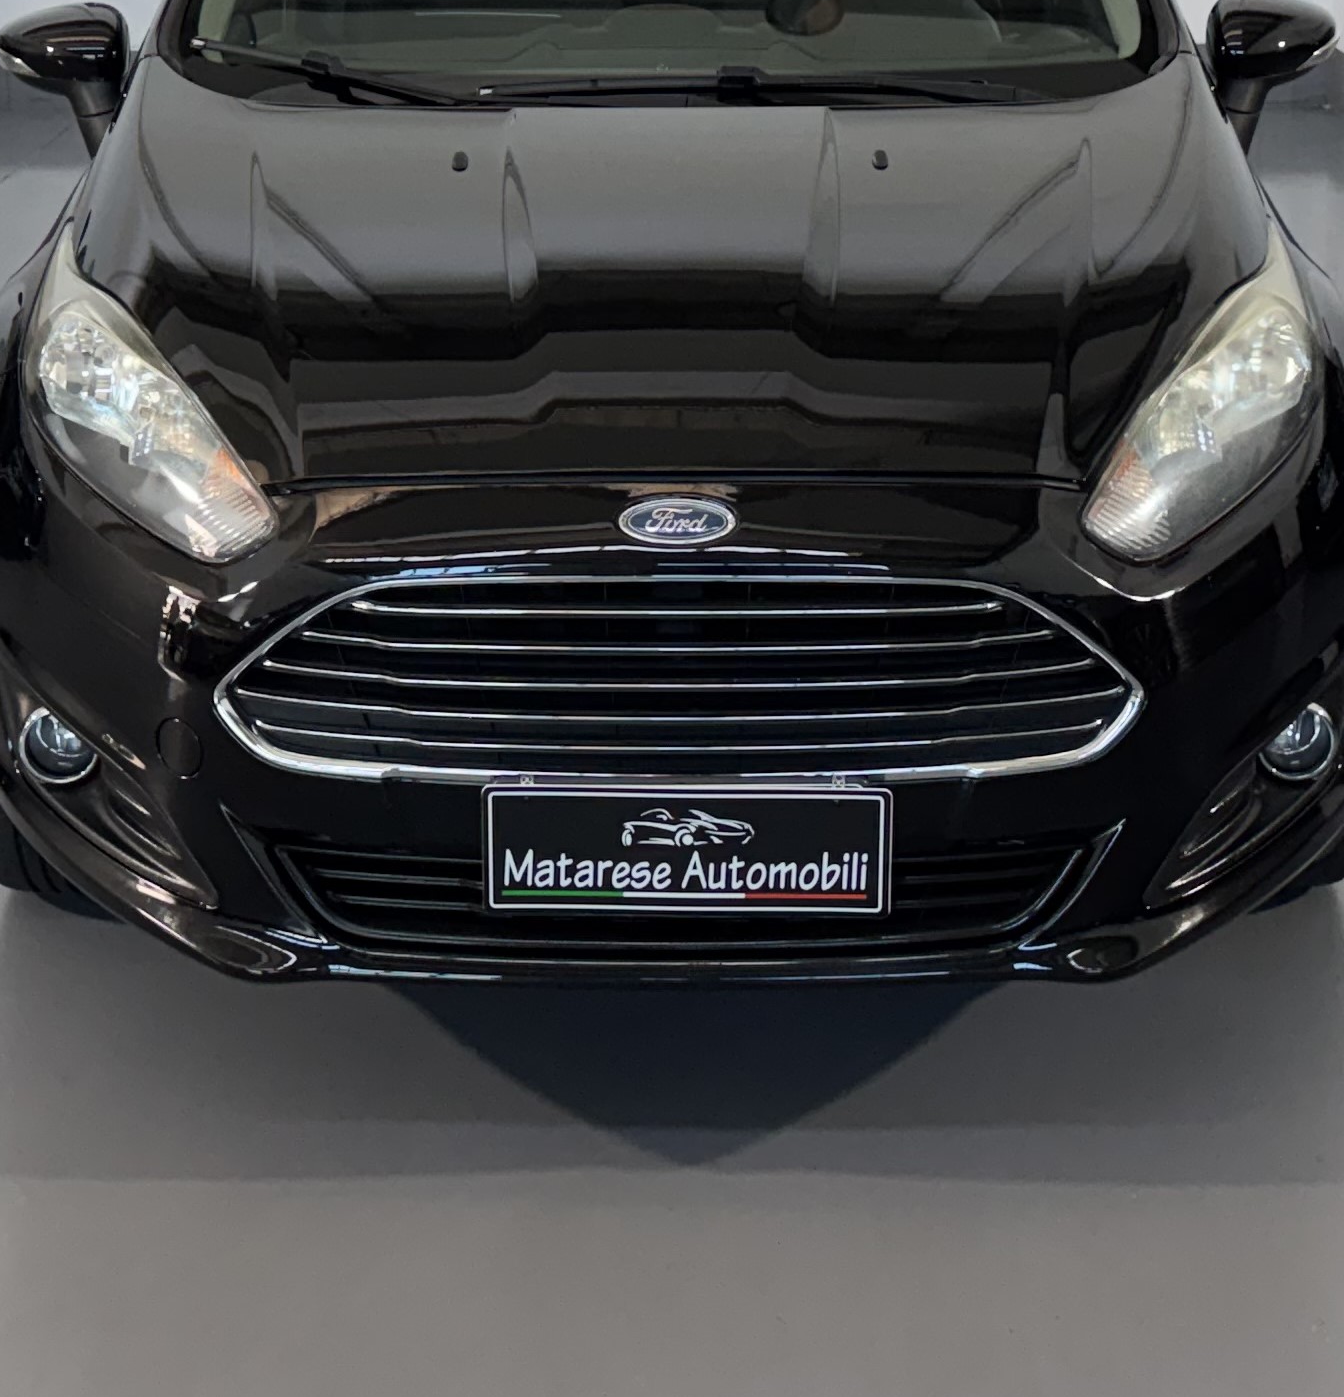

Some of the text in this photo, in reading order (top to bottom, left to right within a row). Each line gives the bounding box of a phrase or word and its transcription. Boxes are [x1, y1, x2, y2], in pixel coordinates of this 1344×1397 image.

[644, 507, 709, 534] Ford
[503, 847, 870, 891] Matarese Automobili
